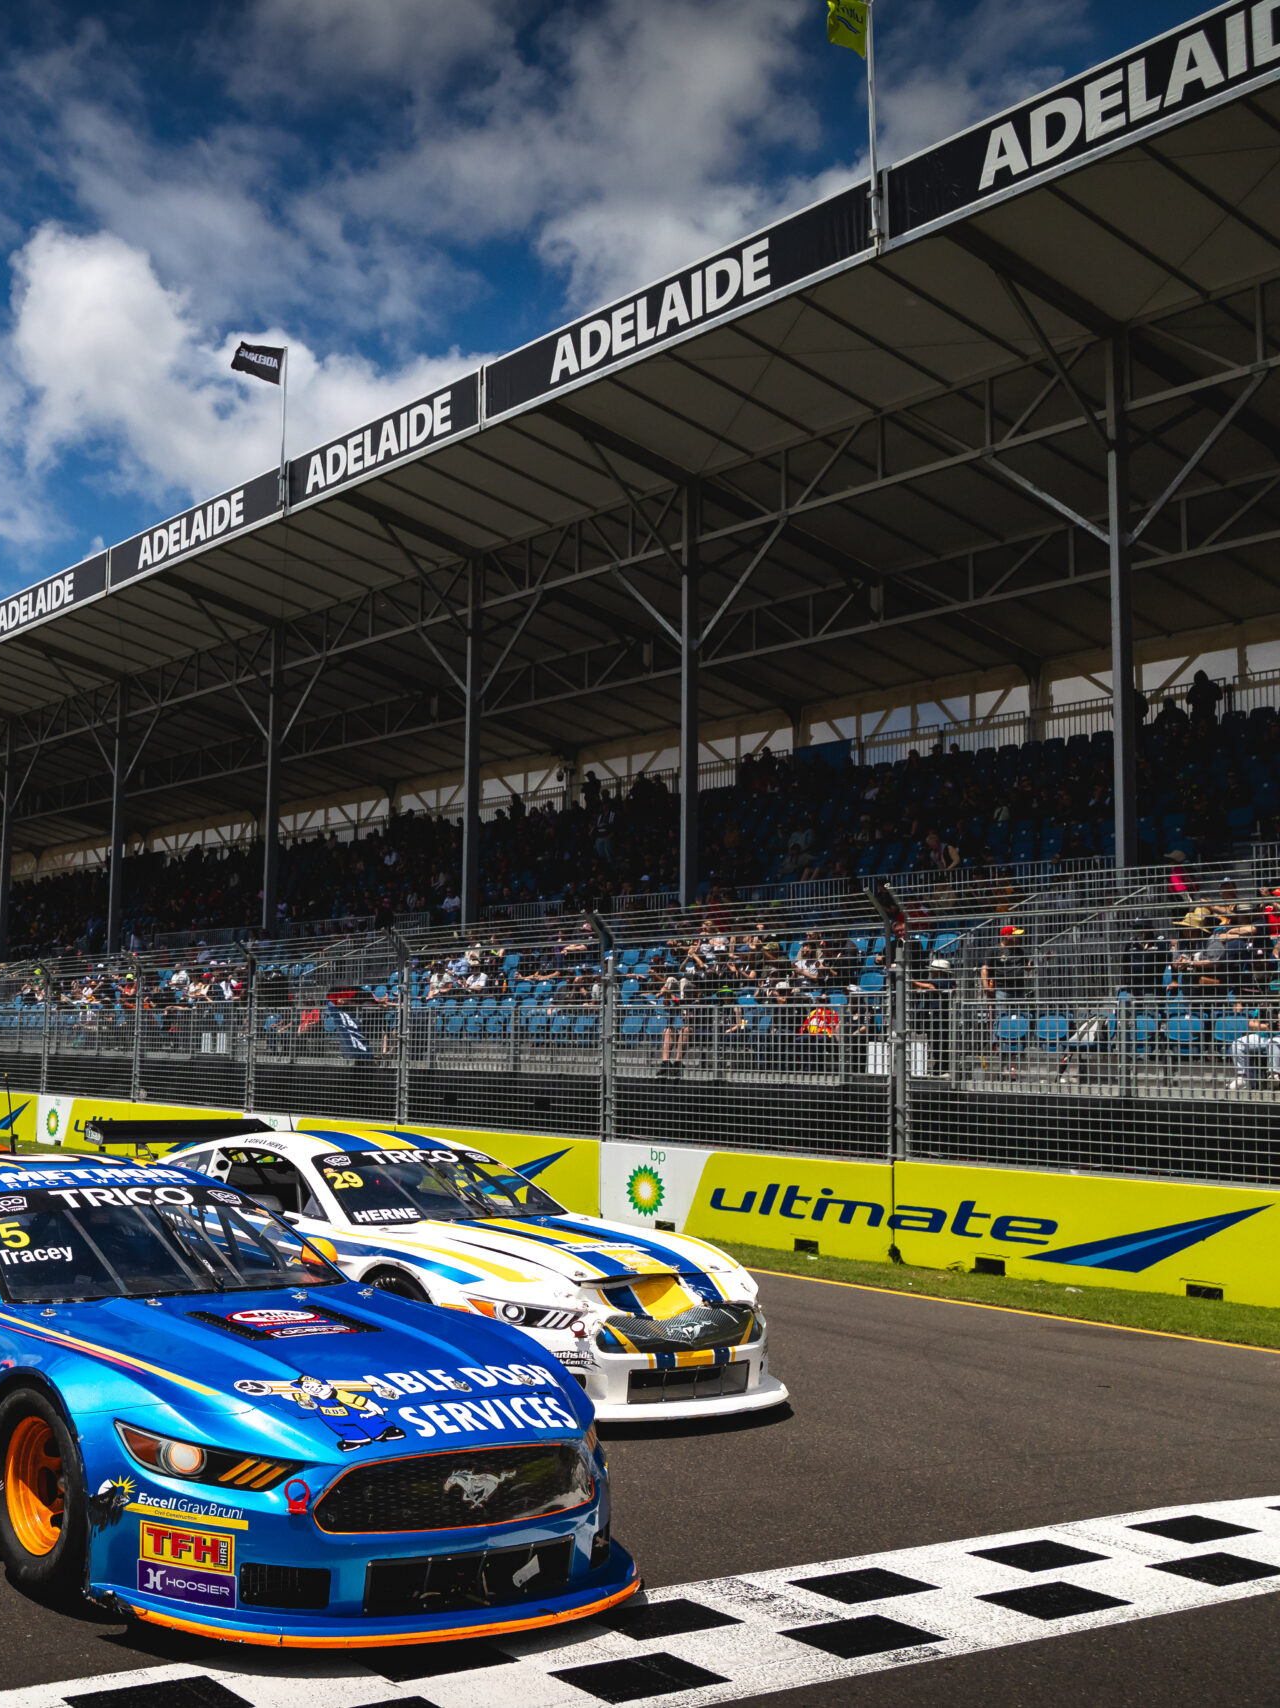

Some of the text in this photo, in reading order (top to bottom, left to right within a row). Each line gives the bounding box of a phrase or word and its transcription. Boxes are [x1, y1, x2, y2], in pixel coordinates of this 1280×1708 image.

[549, 237, 771, 384] ADELAIDE
[305, 391, 452, 494] ADELAIDE
[138, 490, 244, 570] ADELAIDE
[361, 1150, 459, 1164] TRICO
[650, 1147, 666, 1164] bp
[6, 1176, 197, 1189] RACE WHEELS
[326, 1170, 364, 1190] 29
[48, 1187, 195, 1209] TRICO
[353, 1207, 421, 1223] HERNE
[709, 1182, 1059, 1246] ultimate
[362, 1363, 561, 1398] ABLE DOOR
[324, 1407, 346, 1416] ADS
[398, 1396, 578, 1438] SERVICES
[137, 1492, 244, 1520] Excell Gray Bruni
[146, 1527, 228, 1565] TFH HIRE
[166, 1577, 230, 1596] HOOSIER
